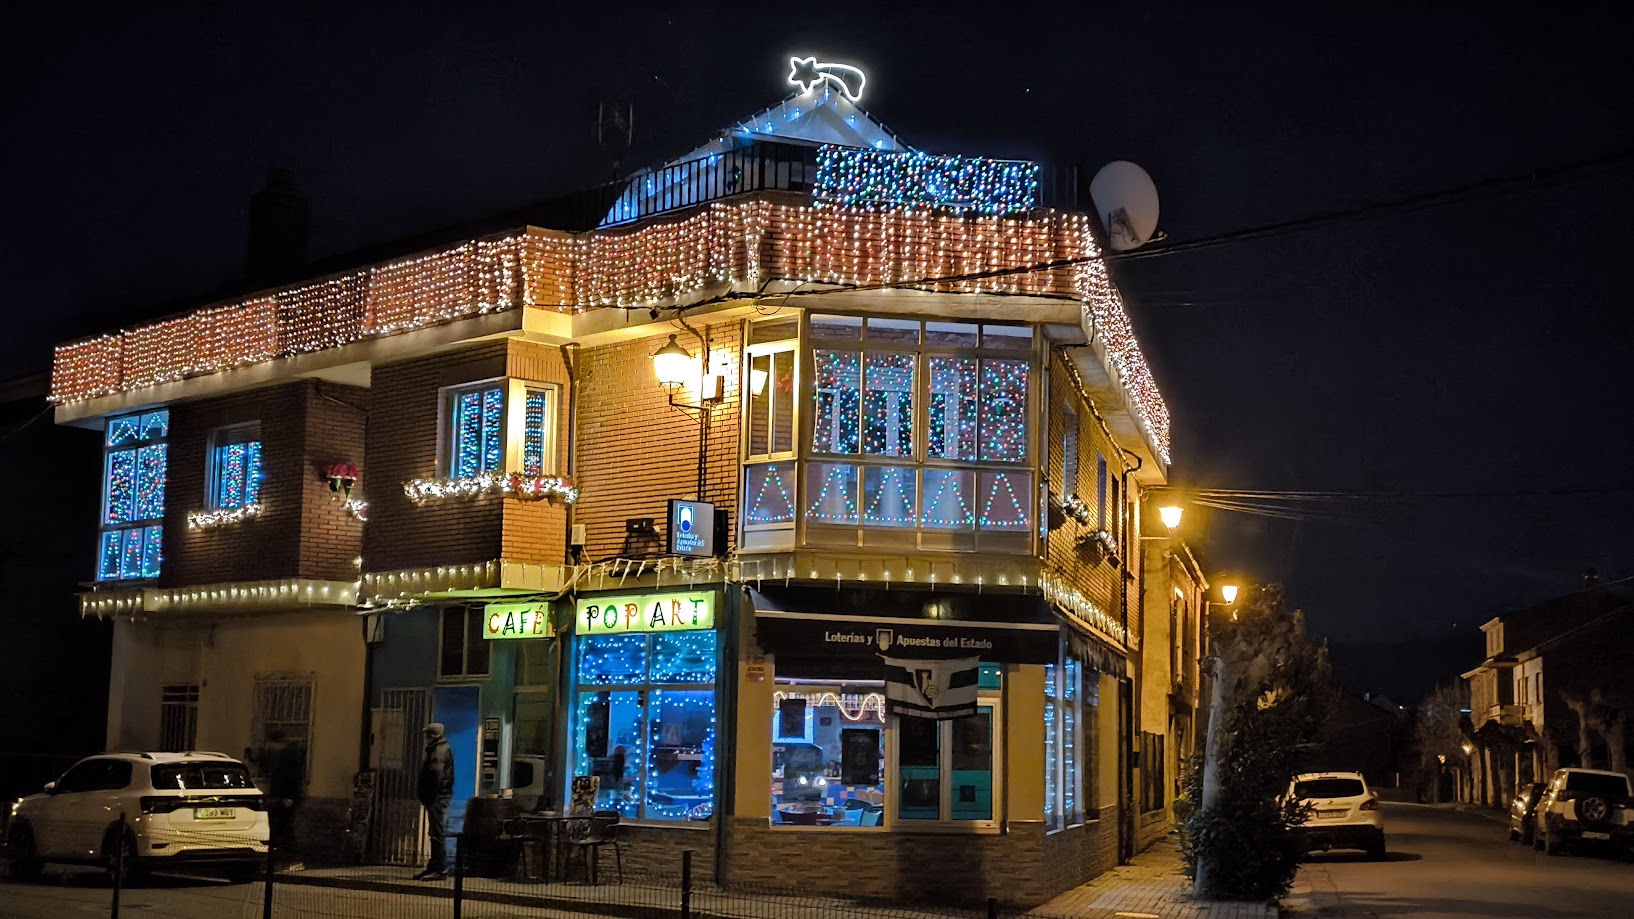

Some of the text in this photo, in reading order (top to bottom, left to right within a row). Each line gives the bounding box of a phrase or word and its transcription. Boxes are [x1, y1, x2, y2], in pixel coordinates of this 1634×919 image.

[488, 605, 546, 636] CAFÉ
[586, 597, 705, 631] POP ART
[825, 631, 993, 650] Loterías y Apuestas del Estado
